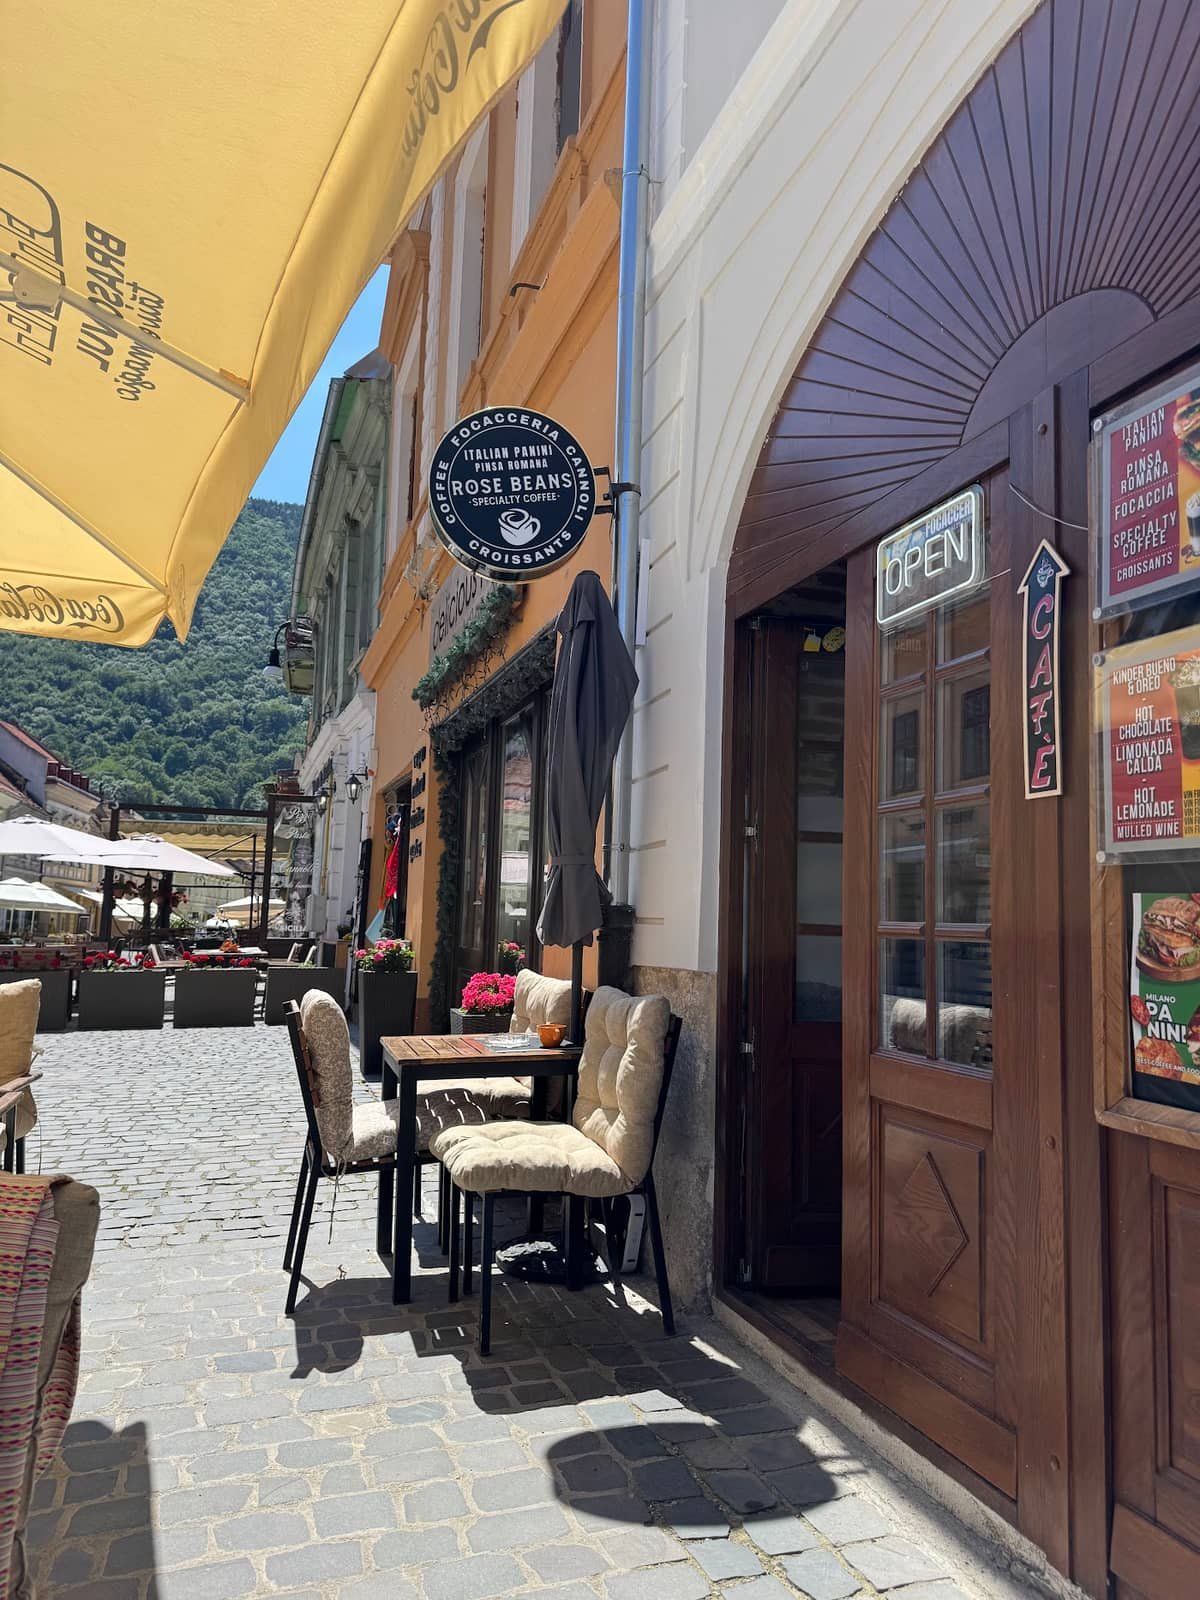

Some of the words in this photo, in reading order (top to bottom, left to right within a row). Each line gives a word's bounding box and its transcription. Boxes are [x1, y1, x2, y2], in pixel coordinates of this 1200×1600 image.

[450, 412, 560, 447] FOCACCERIA
[1122, 407, 1166, 441] ITALIAN
[1125, 421, 1163, 452] PANINI
[464, 448, 509, 461] ITALIAN
[514, 445, 553, 458] PANINI
[474, 461, 504, 473] PINSA
[508, 458, 548, 470] ROMANA
[1126, 449, 1163, 478] PINSA
[451, 478, 503, 496] ROSE
[510, 472, 573, 492] BEANS
[566, 445, 590, 521] CANNOLI
[1120, 460, 1169, 495] ROMANA
[435, 460, 456, 524] COFFEE
[472, 495, 520, 507] SPECIALTY
[523, 492, 557, 503] COFFEE
[1114, 481, 1175, 521] FOCACCIA
[1113, 510, 1178, 549] SPECIALTY
[469, 530, 572, 565] CROISSANTS
[1122, 529, 1167, 559] COFFEE
[885, 522, 966, 595] OPEN
[1116, 551, 1173, 583] CROISSANTS
[1112, 664, 1145, 685] KINDER
[1146, 656, 1176, 677] BUENO
[1127, 681, 1136, 696] &
[1136, 675, 1161, 694] OREO
[1135, 705, 1155, 723] HOT
[1118, 716, 1172, 741] CHOCOLATE
[1115, 737, 1173, 762] LIMONADA
[1126, 755, 1162, 776] CALDA
[1134, 786, 1156, 804] HOT
[1117, 800, 1175, 821] LEMONADE
[1117, 823, 1152, 839] MULLED
[1155, 821, 1180, 836] WINE
[1145, 993, 1176, 1003] MILANO
[1145, 1001, 1173, 1023] PA
